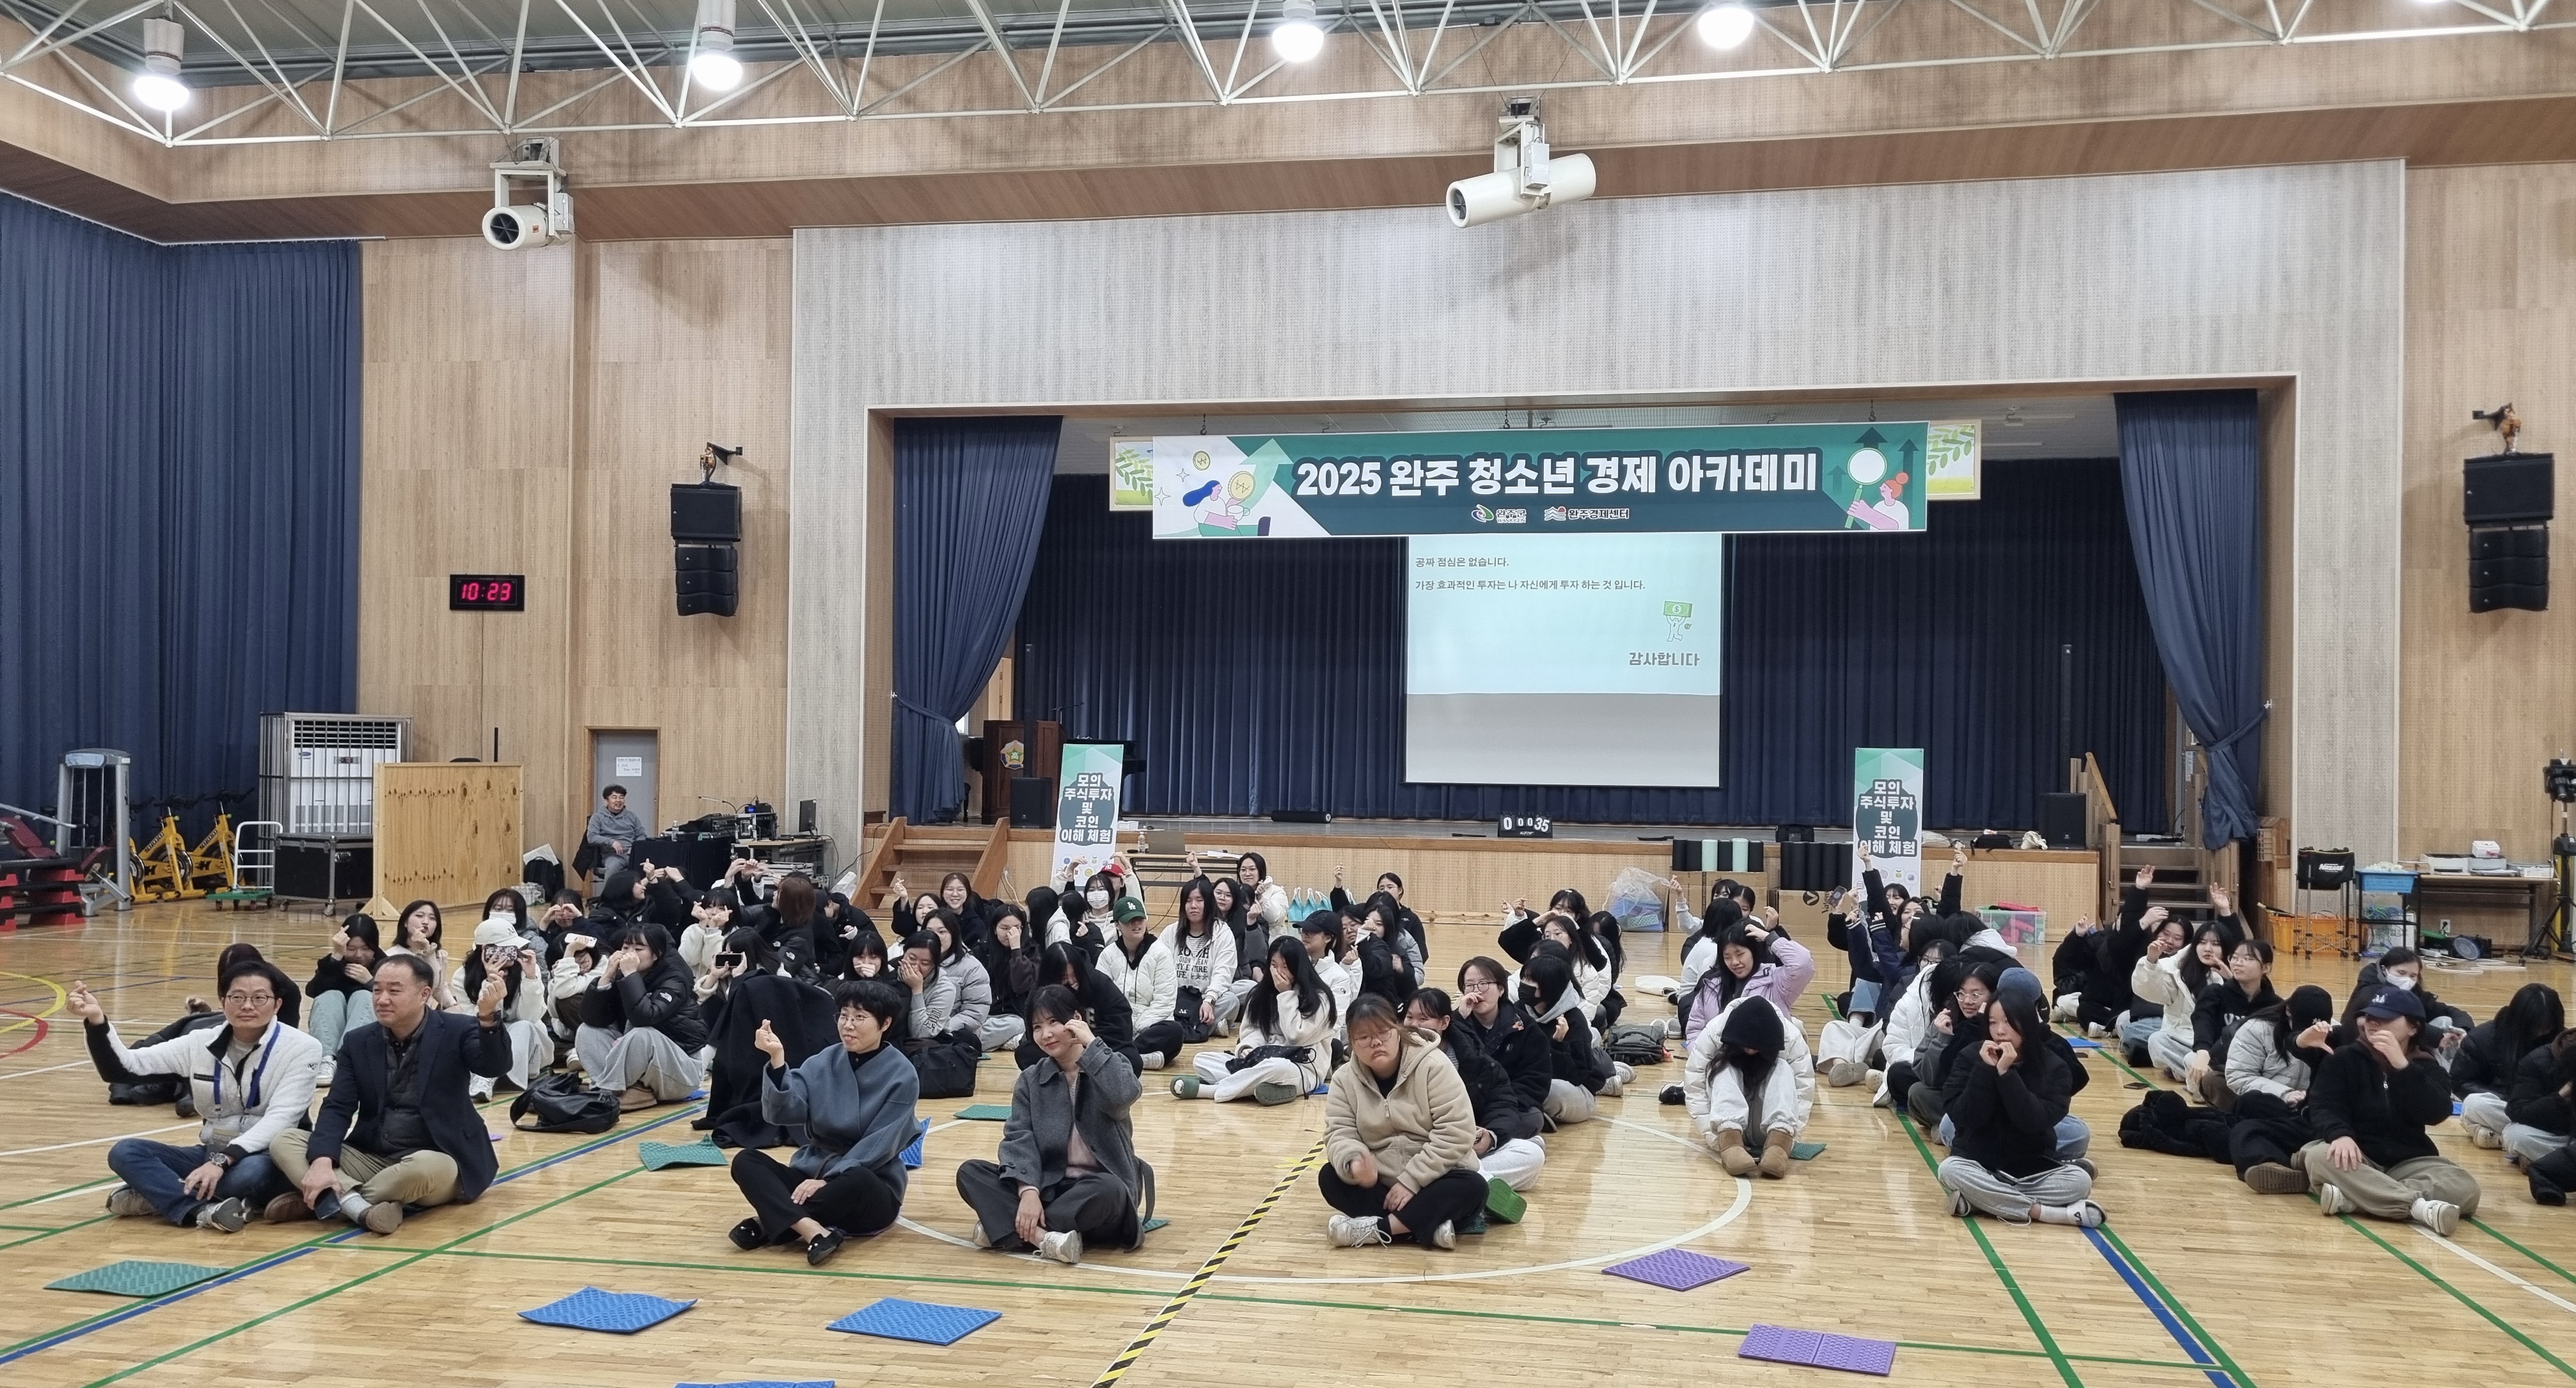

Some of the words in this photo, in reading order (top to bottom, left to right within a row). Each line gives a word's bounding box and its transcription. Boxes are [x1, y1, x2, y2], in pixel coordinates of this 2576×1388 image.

[1297, 462, 1382, 496] 2025
[1390, 460, 1459, 496] 완주
[1468, 457, 1575, 495] 청소년
[1587, 456, 1656, 494] 경제
[1668, 453, 1817, 492] 아카데미
[1496, 509, 1527, 518] 완주군
[1568, 508, 1629, 519] 완주경제센터
[1415, 557, 1436, 568] 공짜
[1437, 557, 1466, 568] 점심은
[1468, 557, 1509, 568] 없습니다.
[462, 582, 511, 600] 10:23
[1415, 580, 1435, 591] 가장
[1436, 580, 1475, 591] 효과적인
[1477, 580, 1507, 591] 투자는
[1508, 580, 1518, 590] 나
[1520, 579, 1559, 591] 자신에게
[1559, 580, 1580, 590] 투자
[1581, 579, 1601, 590] 하는
[1603, 579, 1612, 590] 것
[1614, 579, 1646, 590] 입니다.
[1629, 651, 1700, 667] 감사합니다
[1077, 774, 1101, 788] 모의
[1874, 781, 1900, 795] 모의
[1064, 788, 1113, 801] 주식투자
[1081, 802, 1093, 815] 및
[1860, 795, 1915, 810] 주식투자
[1074, 815, 1099, 829] 코인
[1880, 811, 1892, 825] 및
[1061, 829, 1083, 842] 이해
[1087, 829, 1111, 843] 체험
[1874, 825, 1901, 839] 코인
[1889, 840, 1915, 855] 체험
